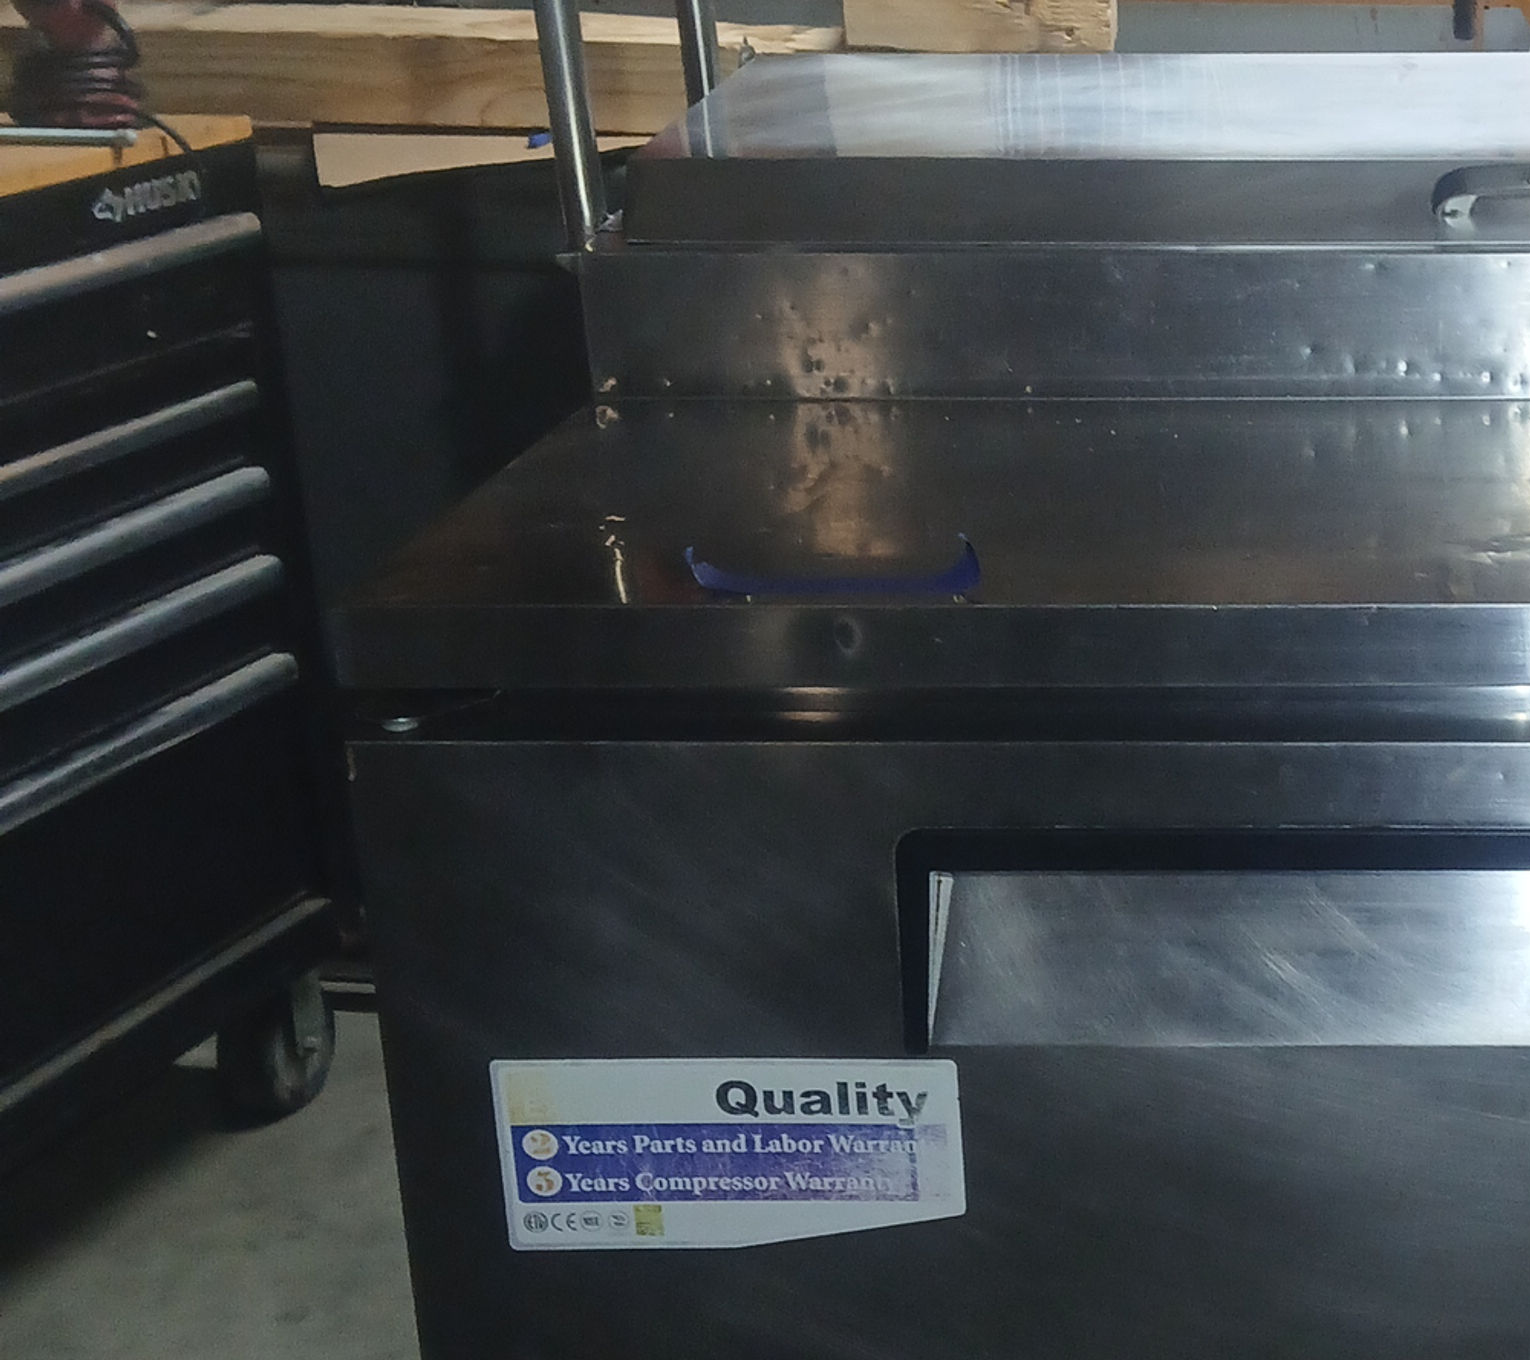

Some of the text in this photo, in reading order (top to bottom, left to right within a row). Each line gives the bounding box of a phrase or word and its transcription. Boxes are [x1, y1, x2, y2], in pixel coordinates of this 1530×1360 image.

[716, 1080, 928, 1126] Quality
[562, 1135, 629, 1155] Years
[632, 1134, 698, 1154] Parts
[702, 1133, 748, 1154] and
[752, 1132, 825, 1154] Labor
[565, 1173, 631, 1192] Years
[635, 1171, 781, 1196] Compressor
